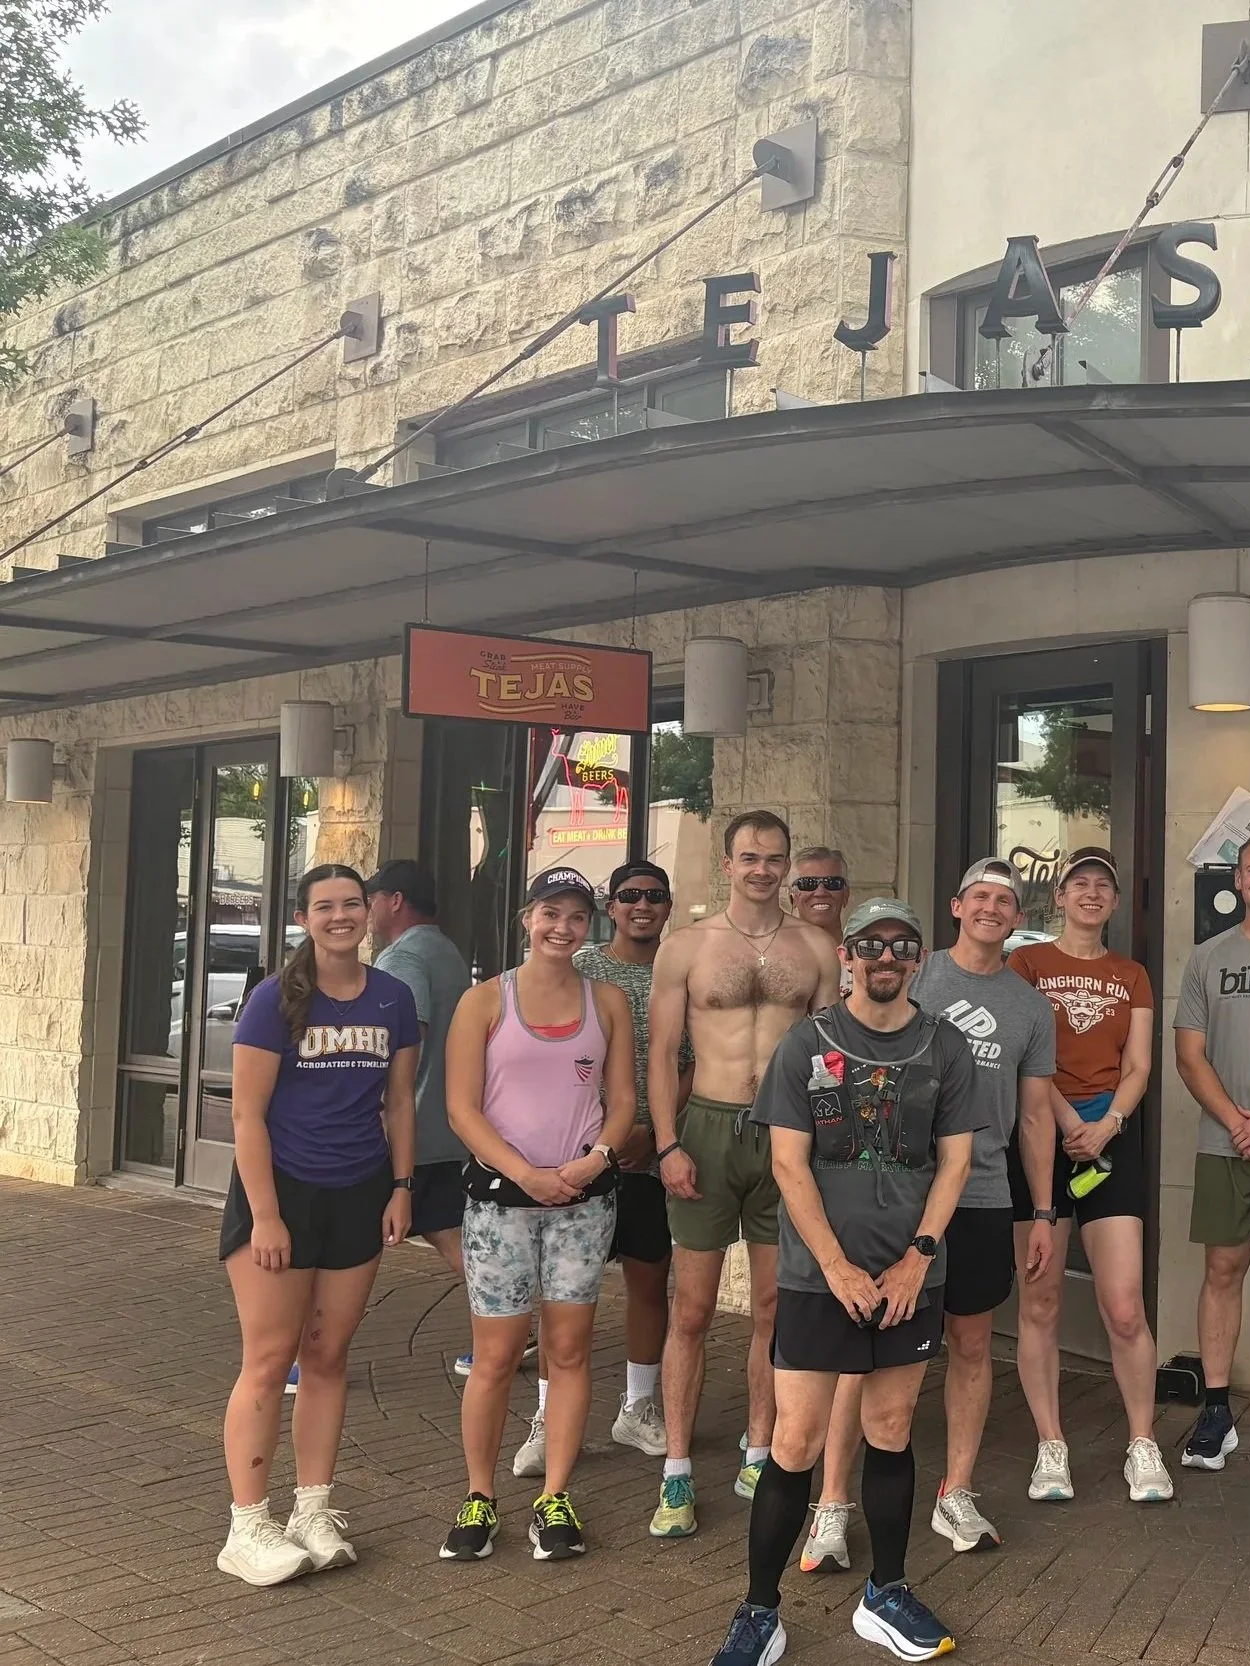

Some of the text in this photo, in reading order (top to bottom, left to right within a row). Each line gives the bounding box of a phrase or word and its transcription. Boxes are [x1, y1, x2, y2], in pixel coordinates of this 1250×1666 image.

[578, 222, 1222, 389] TEJAS
[480, 651, 506, 661] GRAB
[558, 663, 592, 674] SUPPLY
[470, 667, 594, 702] TEJAS
[561, 703, 585, 711] HAVE
[582, 770, 614, 782] BEERS
[553, 827, 627, 843] EAT MEAT DRINK BE
[1105, 1007, 1115, 1016] 23
[299, 1026, 390, 1060] UMHB
[296, 1060, 350, 1069] ACROBATICS
